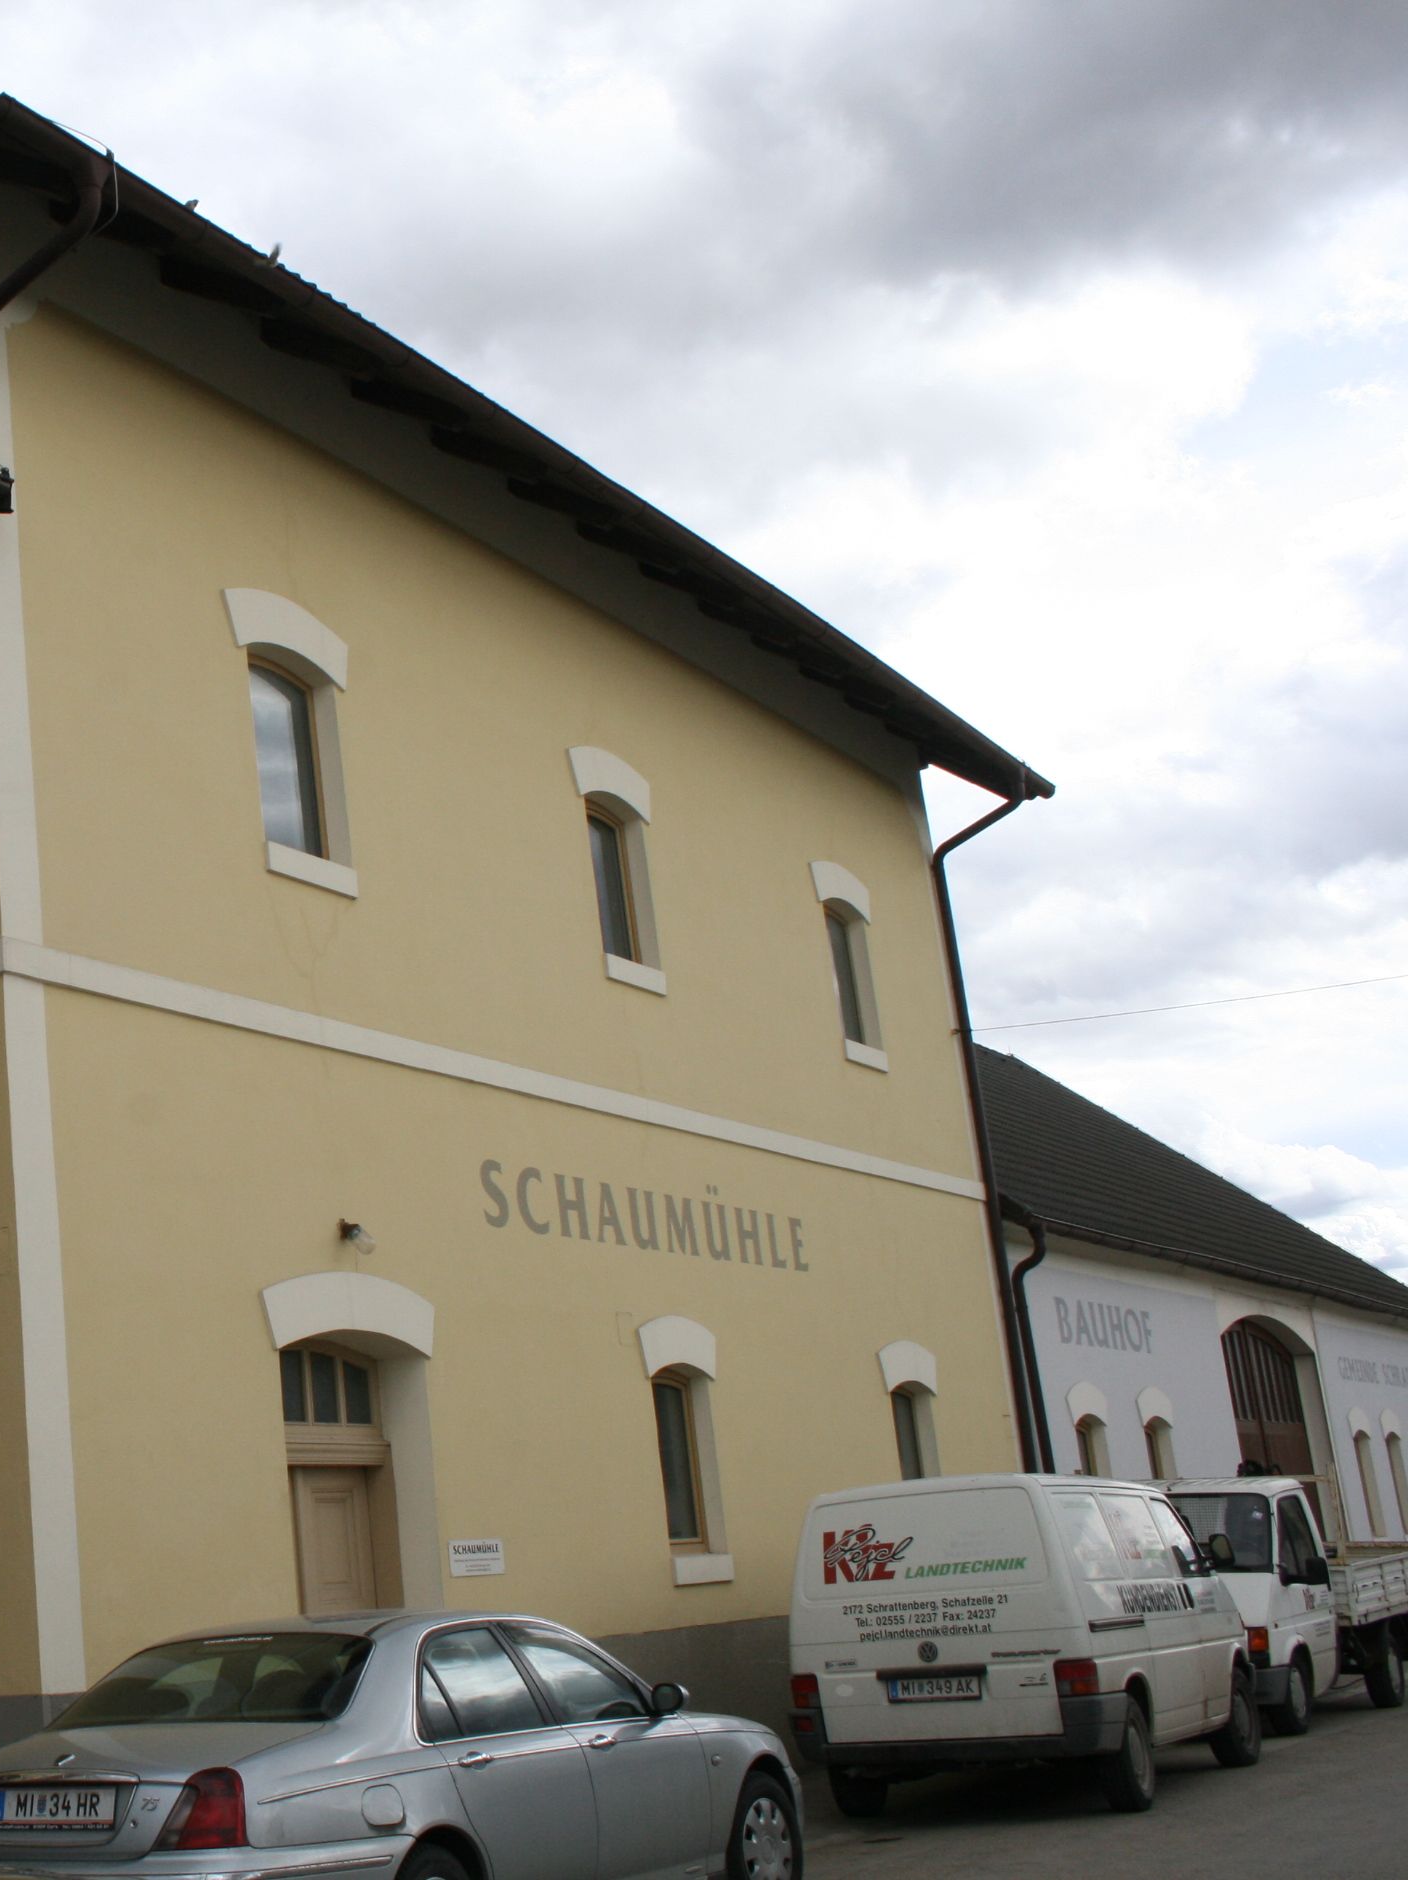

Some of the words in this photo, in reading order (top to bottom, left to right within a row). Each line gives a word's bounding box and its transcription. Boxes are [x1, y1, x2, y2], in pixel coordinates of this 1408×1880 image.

[479, 1158, 809, 1273] SCHAUMÜHLE
[1053, 1296, 1152, 1354] BAUHOF
[453, 1541, 499, 1554] SCHAUMÜHLE
[904, 1557, 1027, 1580] LANDTECHNIK
[843, 1605, 864, 1615] 2172
[867, 1600, 939, 1614] Schrattenberg,
[997, 1594, 1009, 1604] 21
[855, 1617, 873, 1628] Tel.:
[876, 1614, 905, 1626] 02555
[915, 1613, 938, 1624] 2237
[943, 1611, 965, 1622] Fax:
[967, 1609, 997, 1620] 24237
[901, 1681, 916, 1696] MI
[926, 1680, 953, 1695] 349
[956, 1679, 975, 1694] AK
[15, 1794, 34, 1817] MI
[49, 1793, 71, 1817] 34
[76, 1793, 101, 1817] HR
